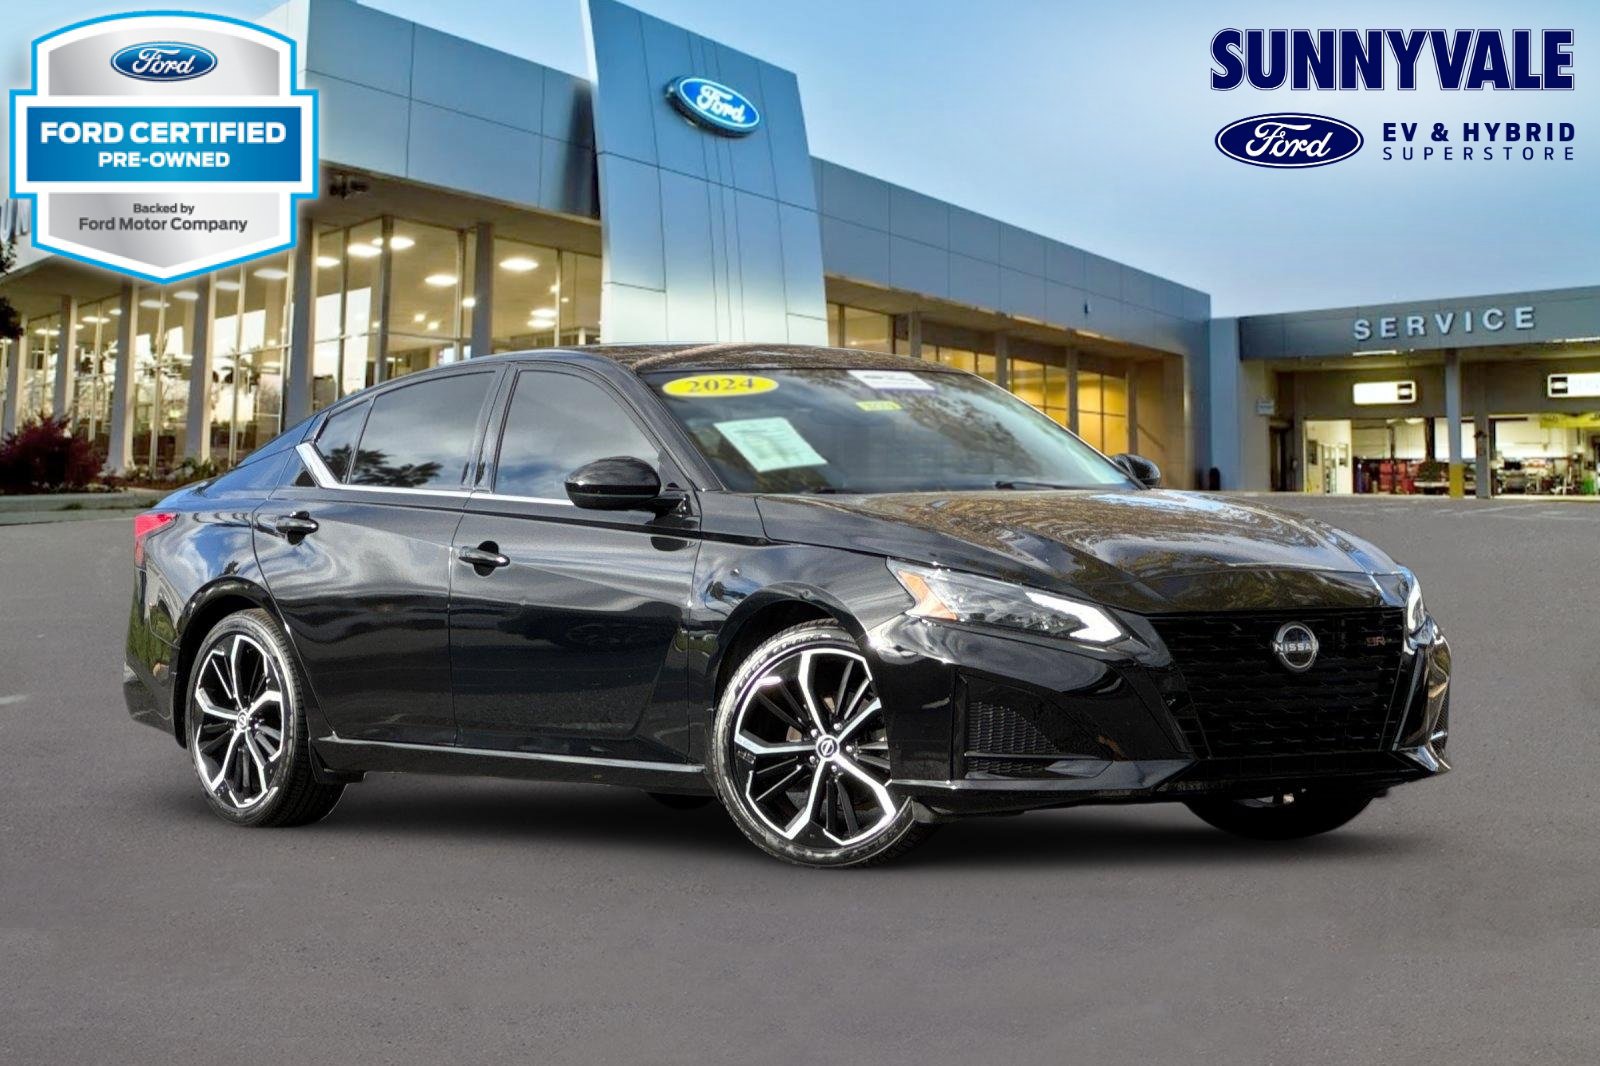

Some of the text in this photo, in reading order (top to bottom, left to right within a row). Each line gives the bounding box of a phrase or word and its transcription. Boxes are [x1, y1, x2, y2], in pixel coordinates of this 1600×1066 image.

[696, 84, 746, 123] Ford
[1353, 306, 1535, 340] SERVICE
[685, 378, 753, 393] 2024
